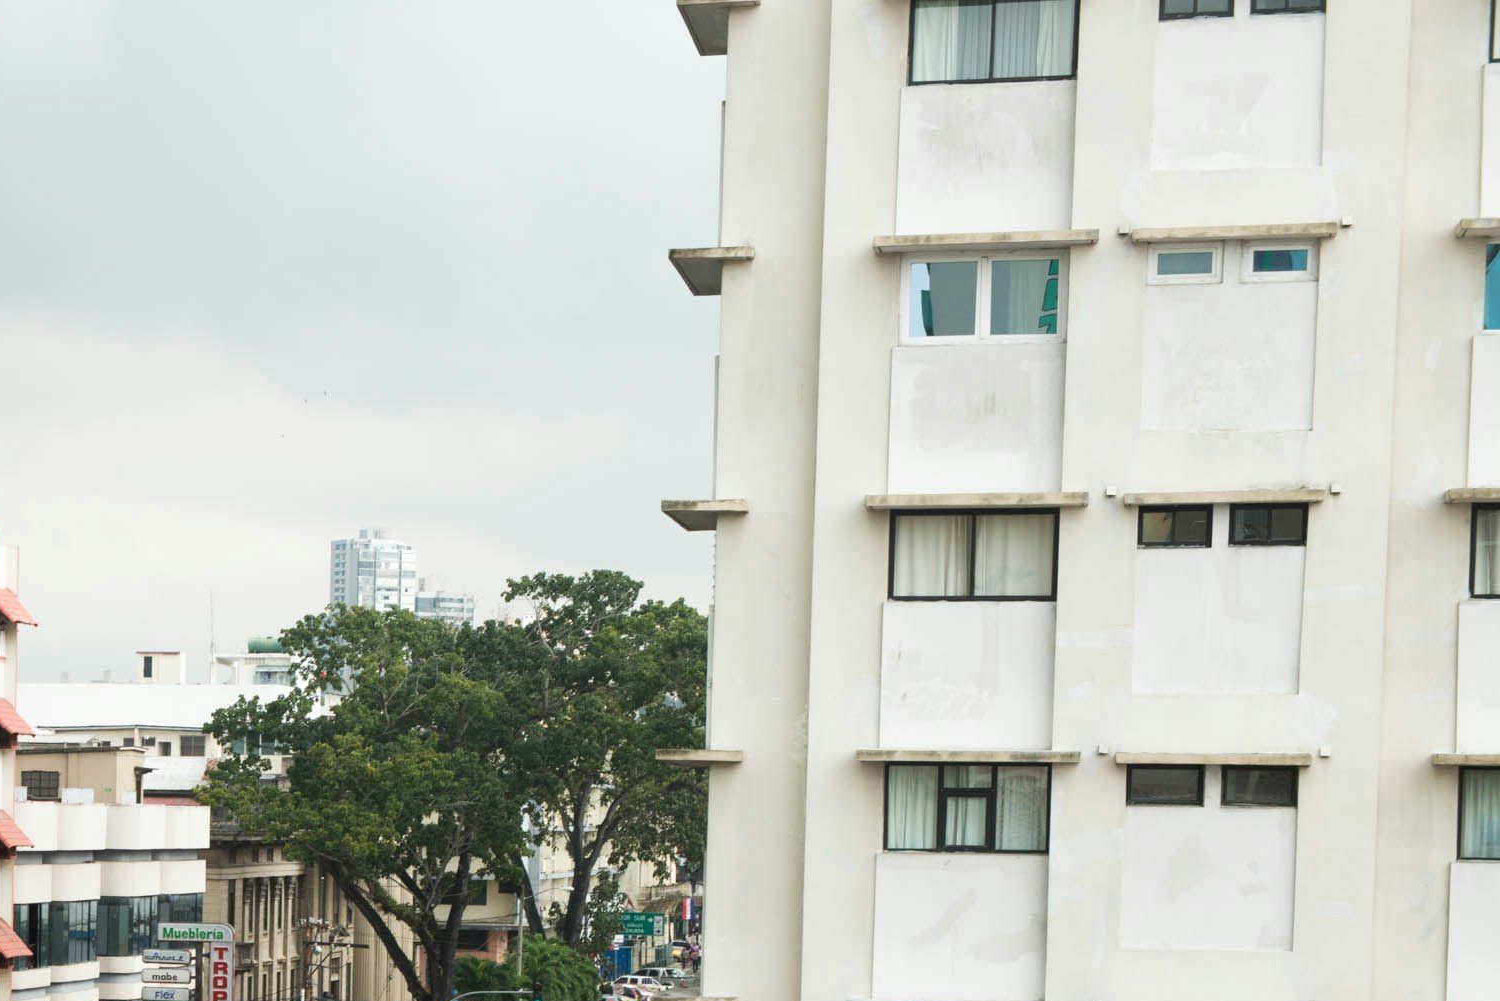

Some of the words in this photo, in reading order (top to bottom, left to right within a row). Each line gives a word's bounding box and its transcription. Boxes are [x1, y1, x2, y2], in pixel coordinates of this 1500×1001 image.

[163, 928, 223, 939] Muebleria
[152, 972, 178, 981] mabe
[155, 991, 175, 1000] Flex
